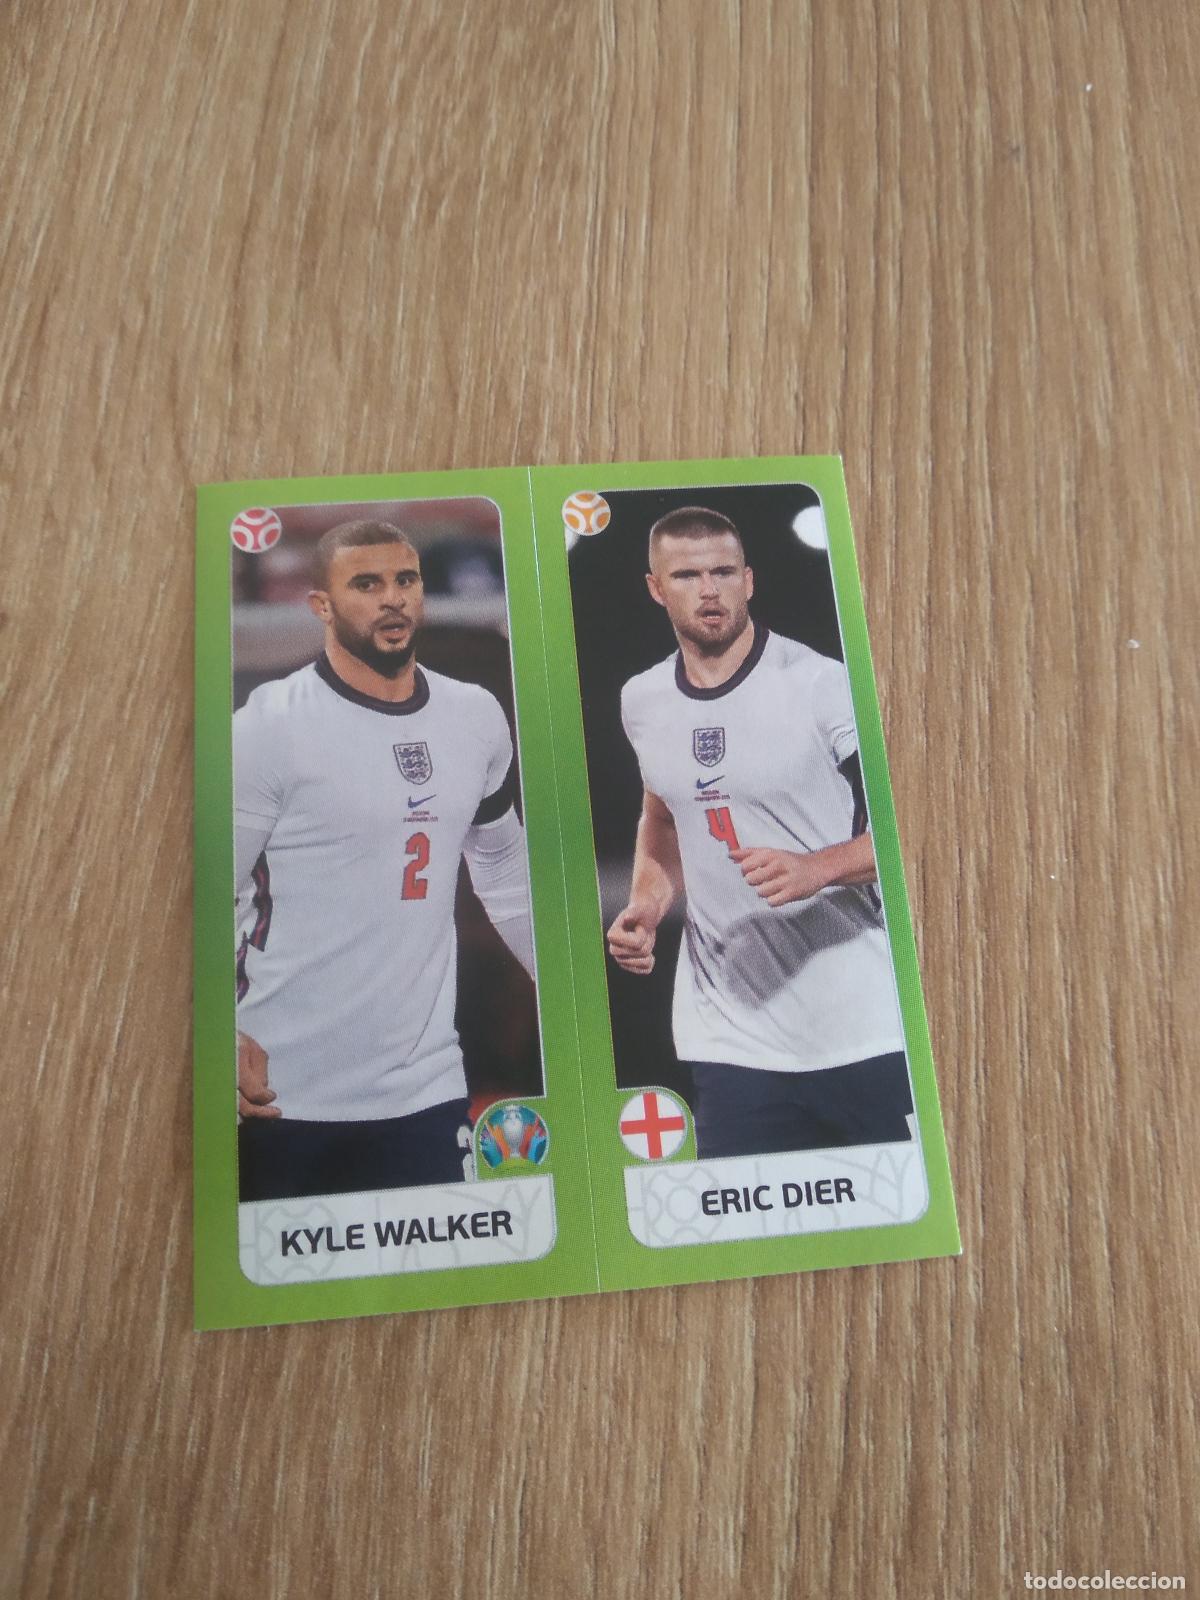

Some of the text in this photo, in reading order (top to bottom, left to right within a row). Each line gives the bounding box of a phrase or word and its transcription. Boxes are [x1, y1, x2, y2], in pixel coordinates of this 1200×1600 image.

[704, 807, 741, 852] 4
[400, 831, 430, 901] 2
[701, 1178, 856, 1216] ERIC DIER
[281, 1210, 514, 1257] KYLE WALKER
